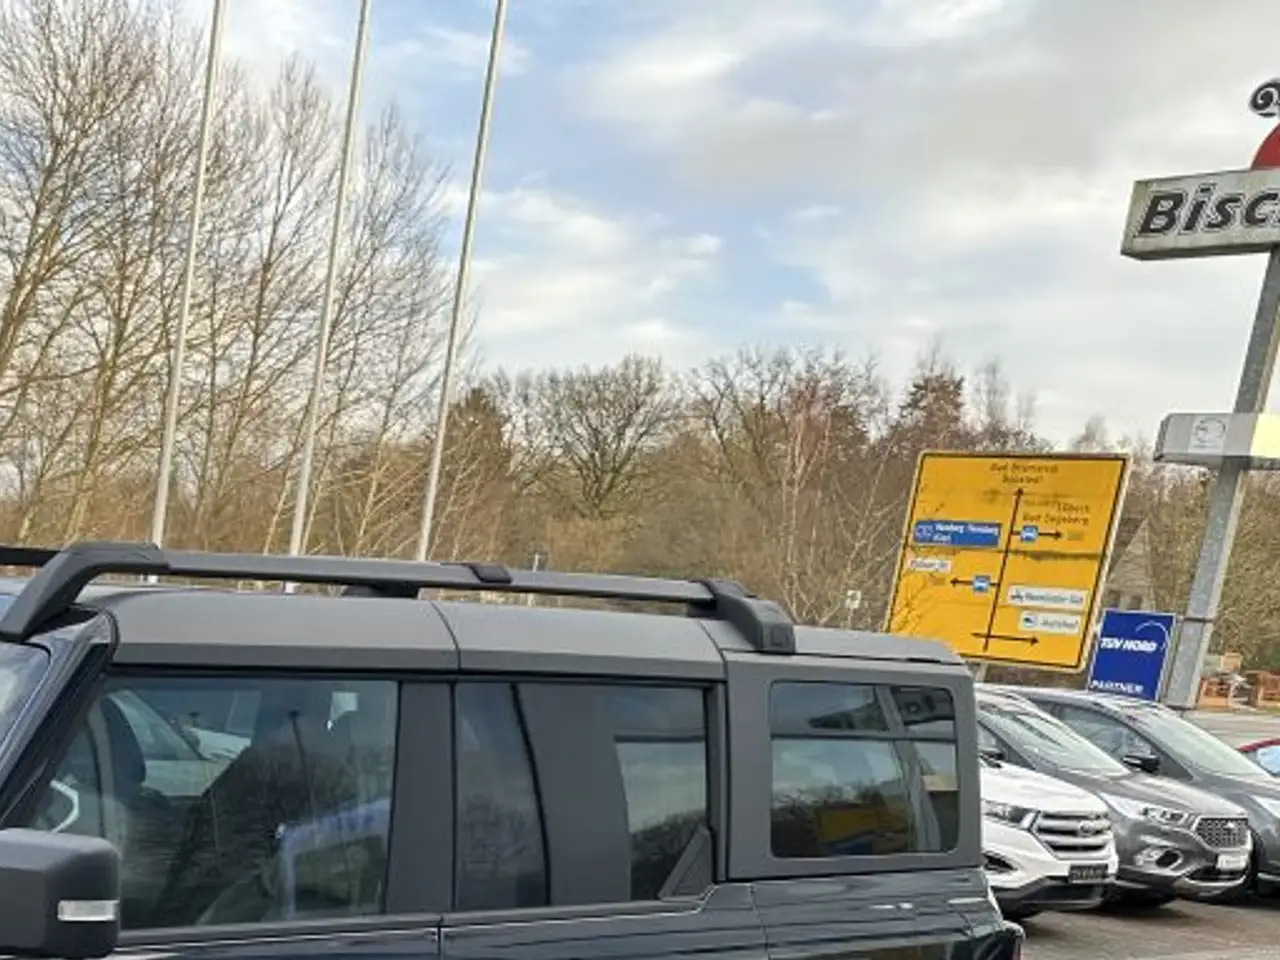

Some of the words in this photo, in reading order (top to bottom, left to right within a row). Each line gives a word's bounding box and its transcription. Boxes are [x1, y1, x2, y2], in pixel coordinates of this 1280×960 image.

[1137, 184, 1280, 234] Bisc
[1122, 638, 1158, 653] NORD
[1089, 679, 1144, 694] PARTNER
